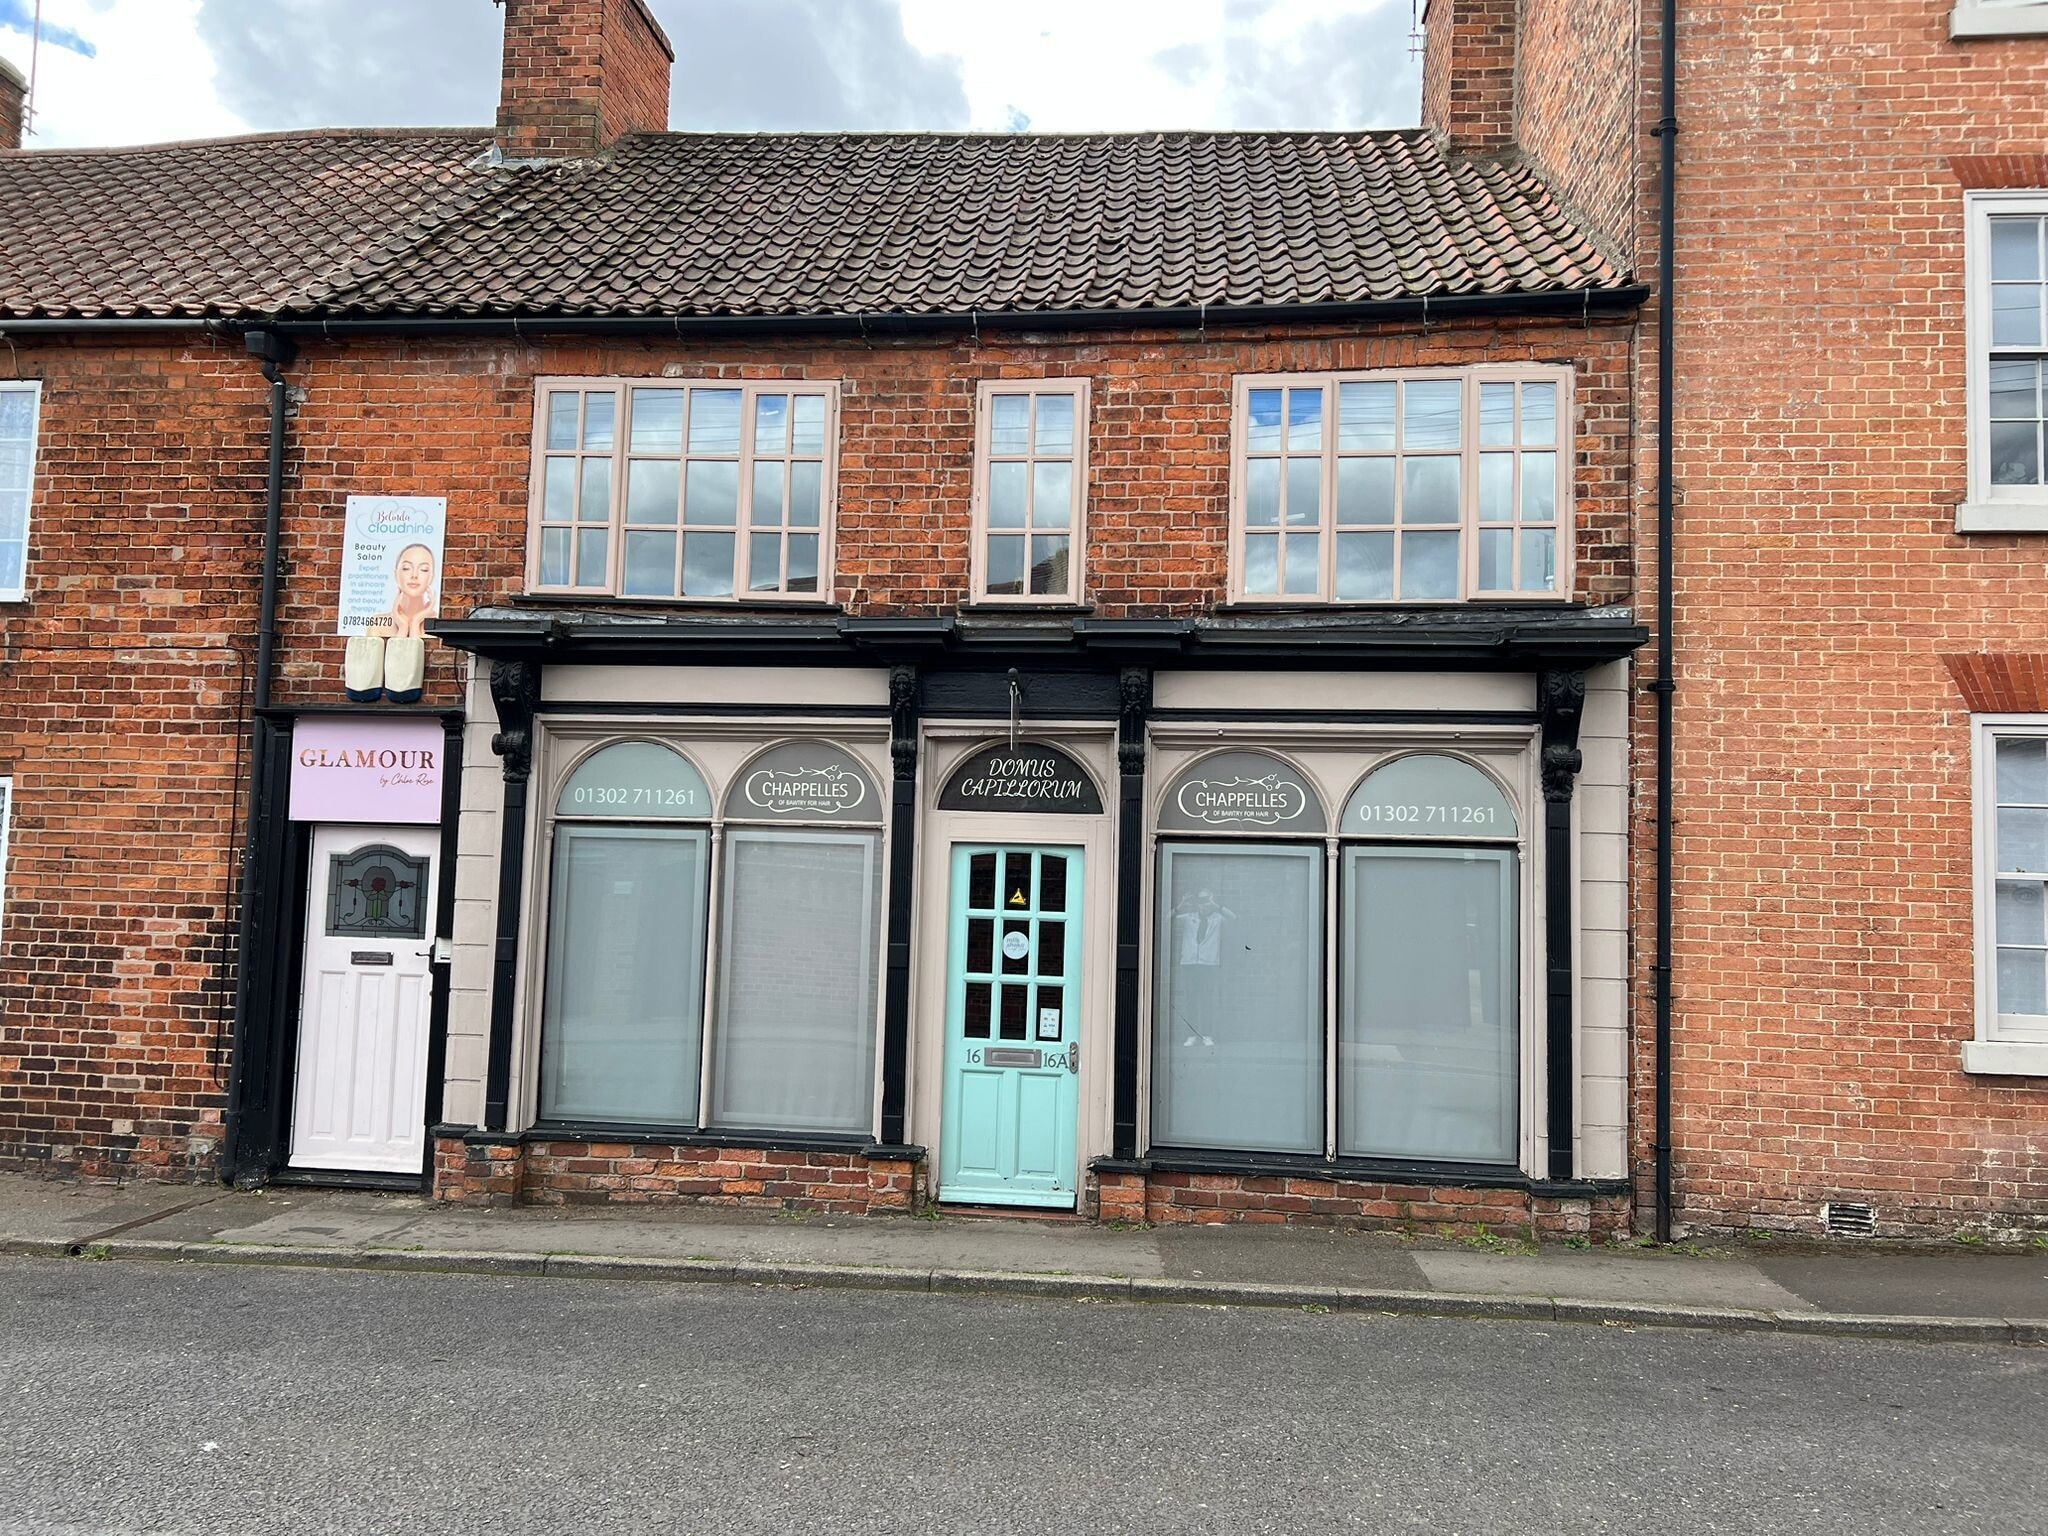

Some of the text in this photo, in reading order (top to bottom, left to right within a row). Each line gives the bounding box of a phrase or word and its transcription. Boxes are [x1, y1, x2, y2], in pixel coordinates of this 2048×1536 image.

[368, 522, 434, 534] cloudnine
[354, 543, 387, 552] Beauty
[357, 552, 383, 561] Salon
[343, 615, 393, 627] 07824664720
[300, 748, 435, 769] GLAMOUR
[989, 758, 1055, 778] DOMUS
[574, 787, 694, 805] 01302 711261
[762, 782, 848, 798] CHAPPELLES
[961, 778, 1082, 799] CAPILLORUM
[1195, 792, 1288, 808] CHAPPELLES
[1360, 805, 1494, 823] 01302 711261
[966, 1048, 981, 1064] 16
[1043, 1052, 1069, 1070] 16A
